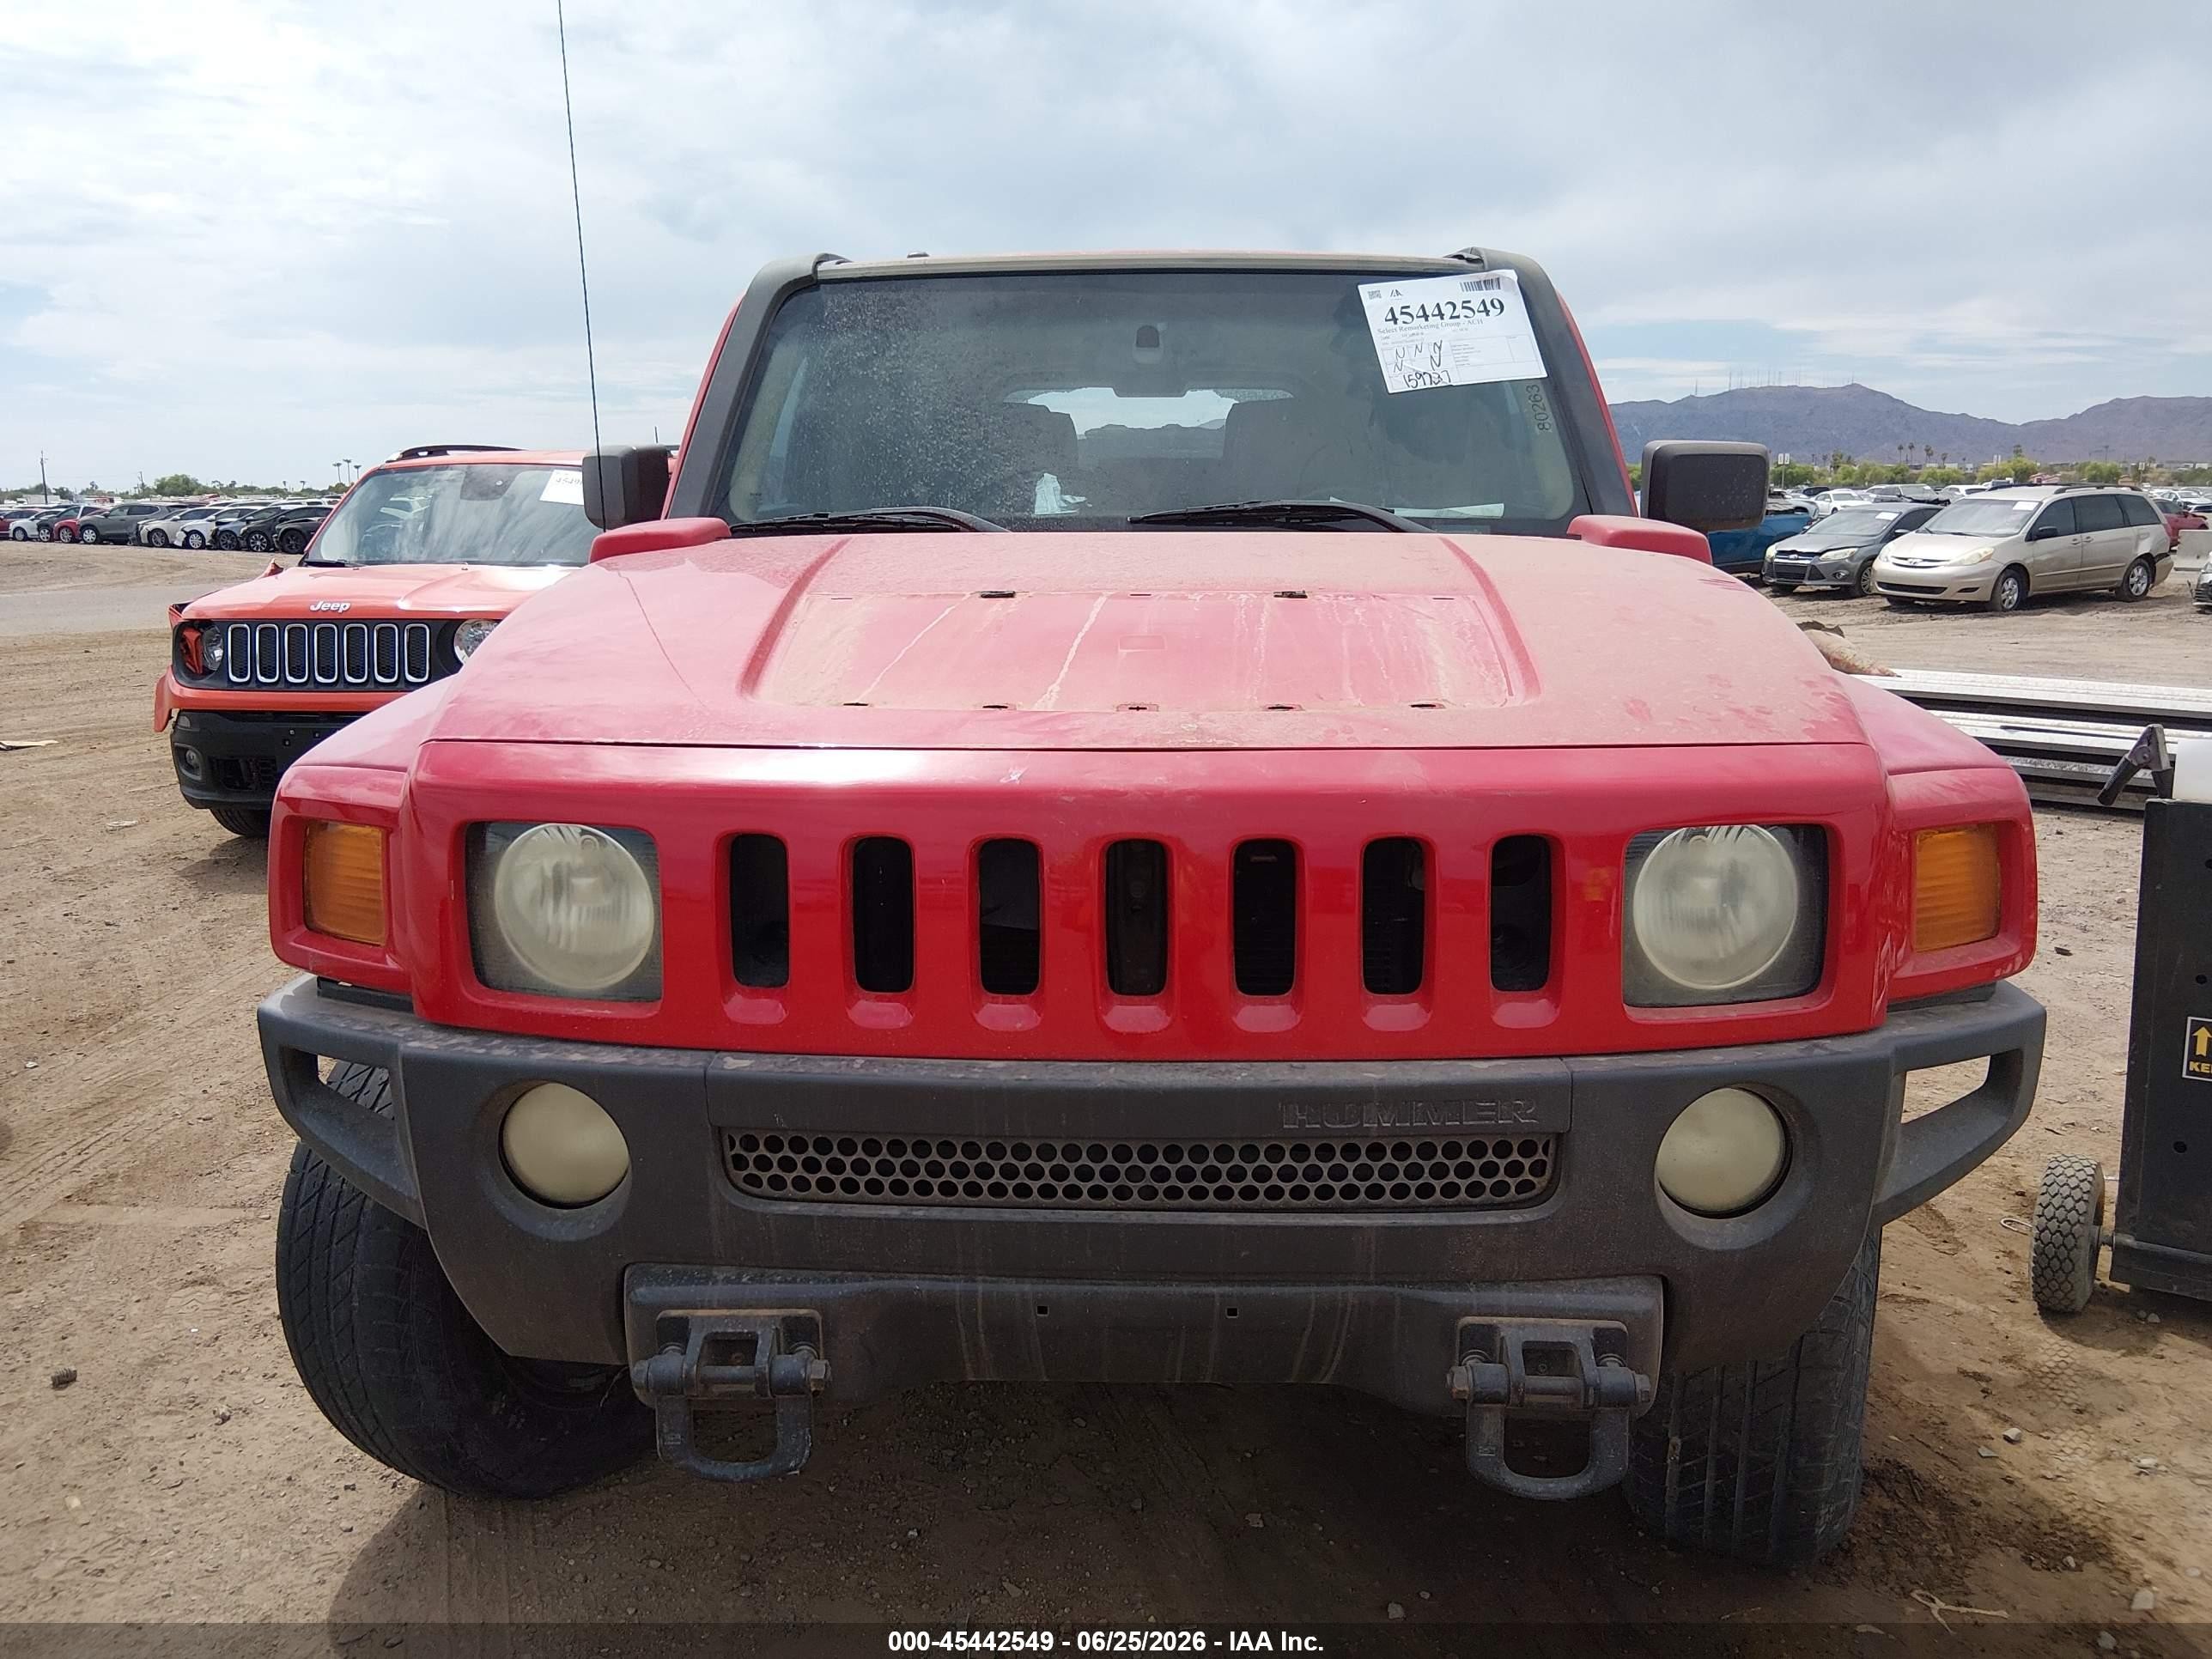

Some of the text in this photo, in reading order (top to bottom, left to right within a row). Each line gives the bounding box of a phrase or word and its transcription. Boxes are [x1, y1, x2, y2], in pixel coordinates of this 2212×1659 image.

[1385, 298, 1504, 325] 45442549
[1400, 322, 1439, 332] Remarketing
[1441, 320, 1461, 329] Group
[1526, 384, 1553, 431] 80263
[309, 600, 351, 614] Jeep
[2189, 1060, 2212, 1074] KE
[1279, 1099, 1539, 1129] HUMMER
